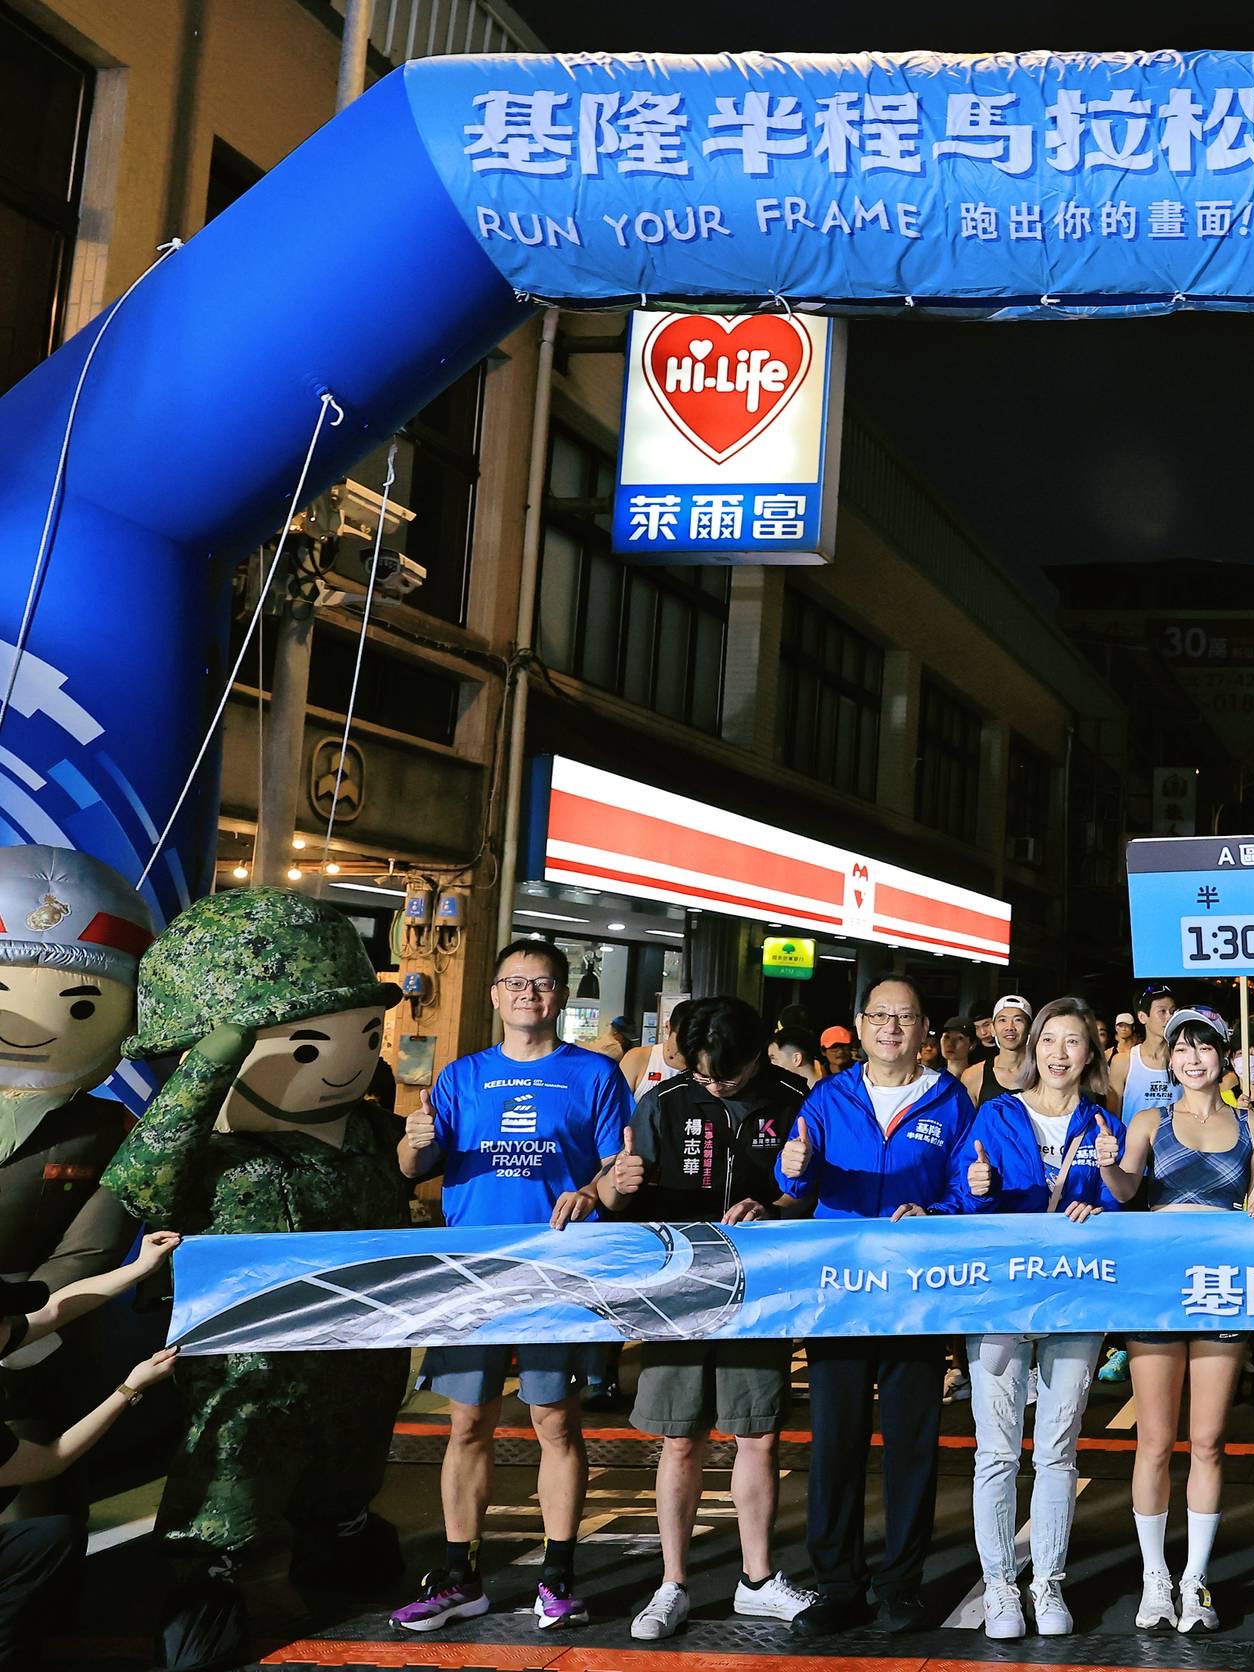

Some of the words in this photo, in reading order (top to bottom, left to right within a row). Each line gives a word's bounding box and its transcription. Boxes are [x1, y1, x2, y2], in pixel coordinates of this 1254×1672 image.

[476, 206, 579, 247] RUN
[602, 203, 729, 248] YOUR
[757, 196, 921, 239] FRAME
[960, 199, 1254, 241] 跑出你的畫面!
[665, 339, 789, 413] Hi-Life
[628, 494, 807, 541] 萊爾富
[483, 1079, 532, 1090] KEELUNG
[480, 1140, 513, 1153] RUN
[513, 1140, 556, 1154] YOUR
[492, 1154, 543, 1166] FRAME
[683, 1118, 702, 1175] 楊志華
[496, 1168, 531, 1178] 2026
[819, 1265, 889, 1292] RUN
[906, 1262, 990, 1290] YOUR
[1008, 1255, 1118, 1283] FRAME
